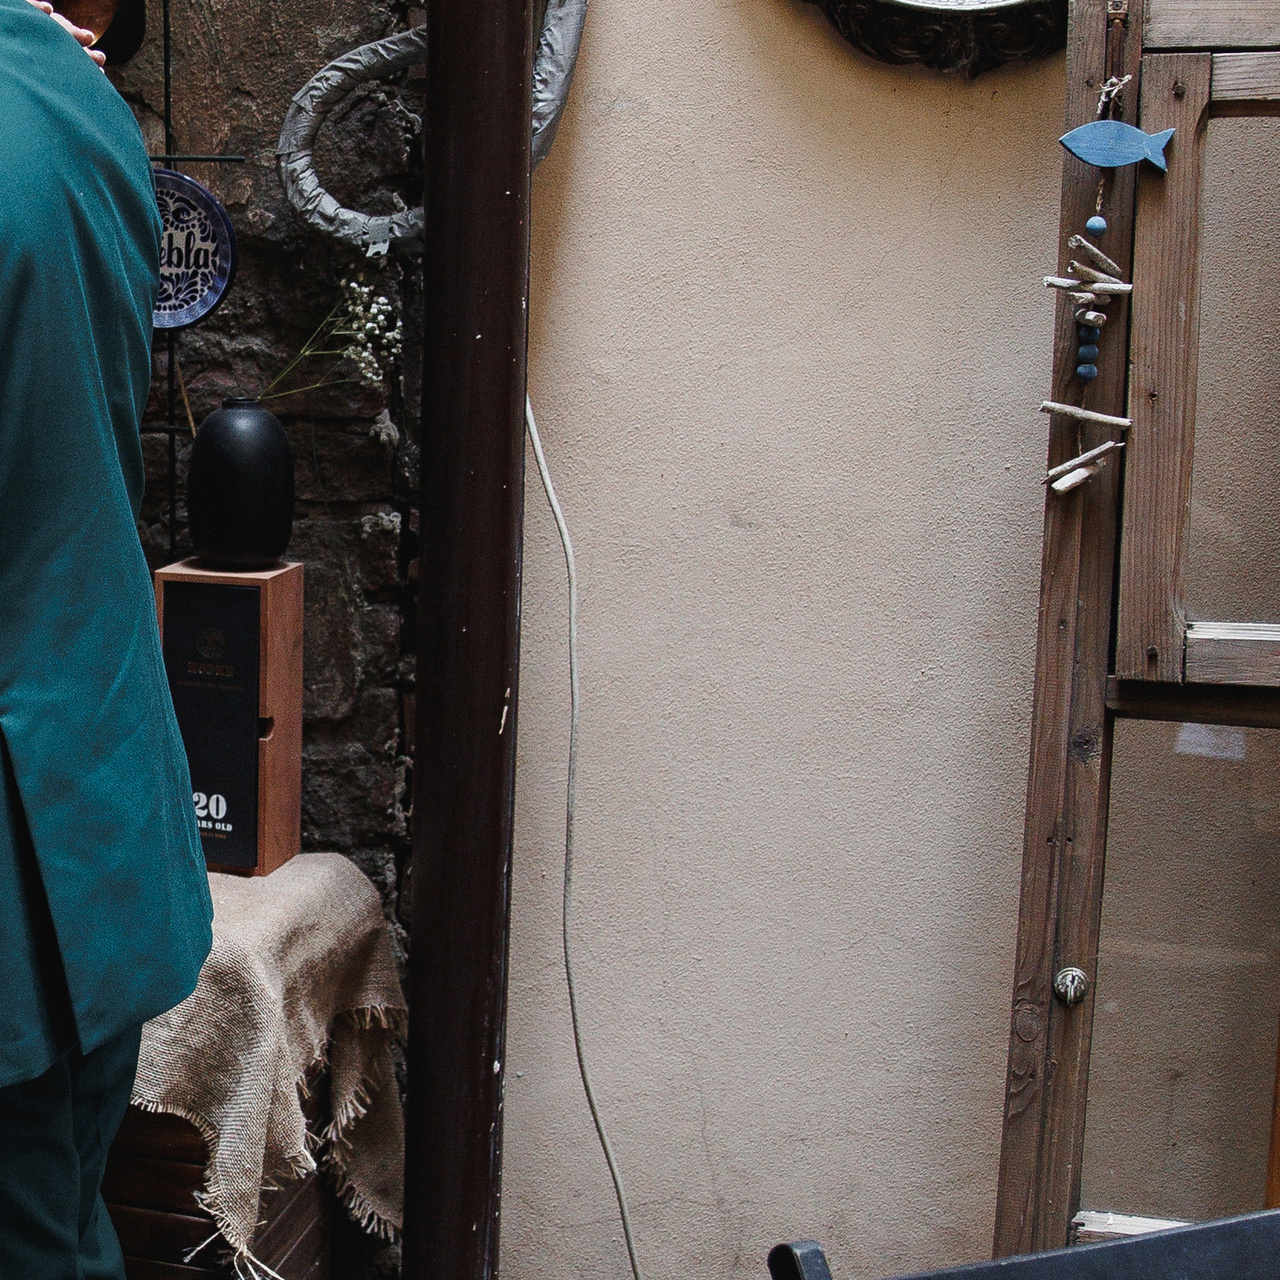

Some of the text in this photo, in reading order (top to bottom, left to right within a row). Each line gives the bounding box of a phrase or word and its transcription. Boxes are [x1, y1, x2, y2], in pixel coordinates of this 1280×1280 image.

[160, 231, 209, 269] ebla
[192, 792, 227, 819] 20
[197, 820, 233, 832] ARS OLD
